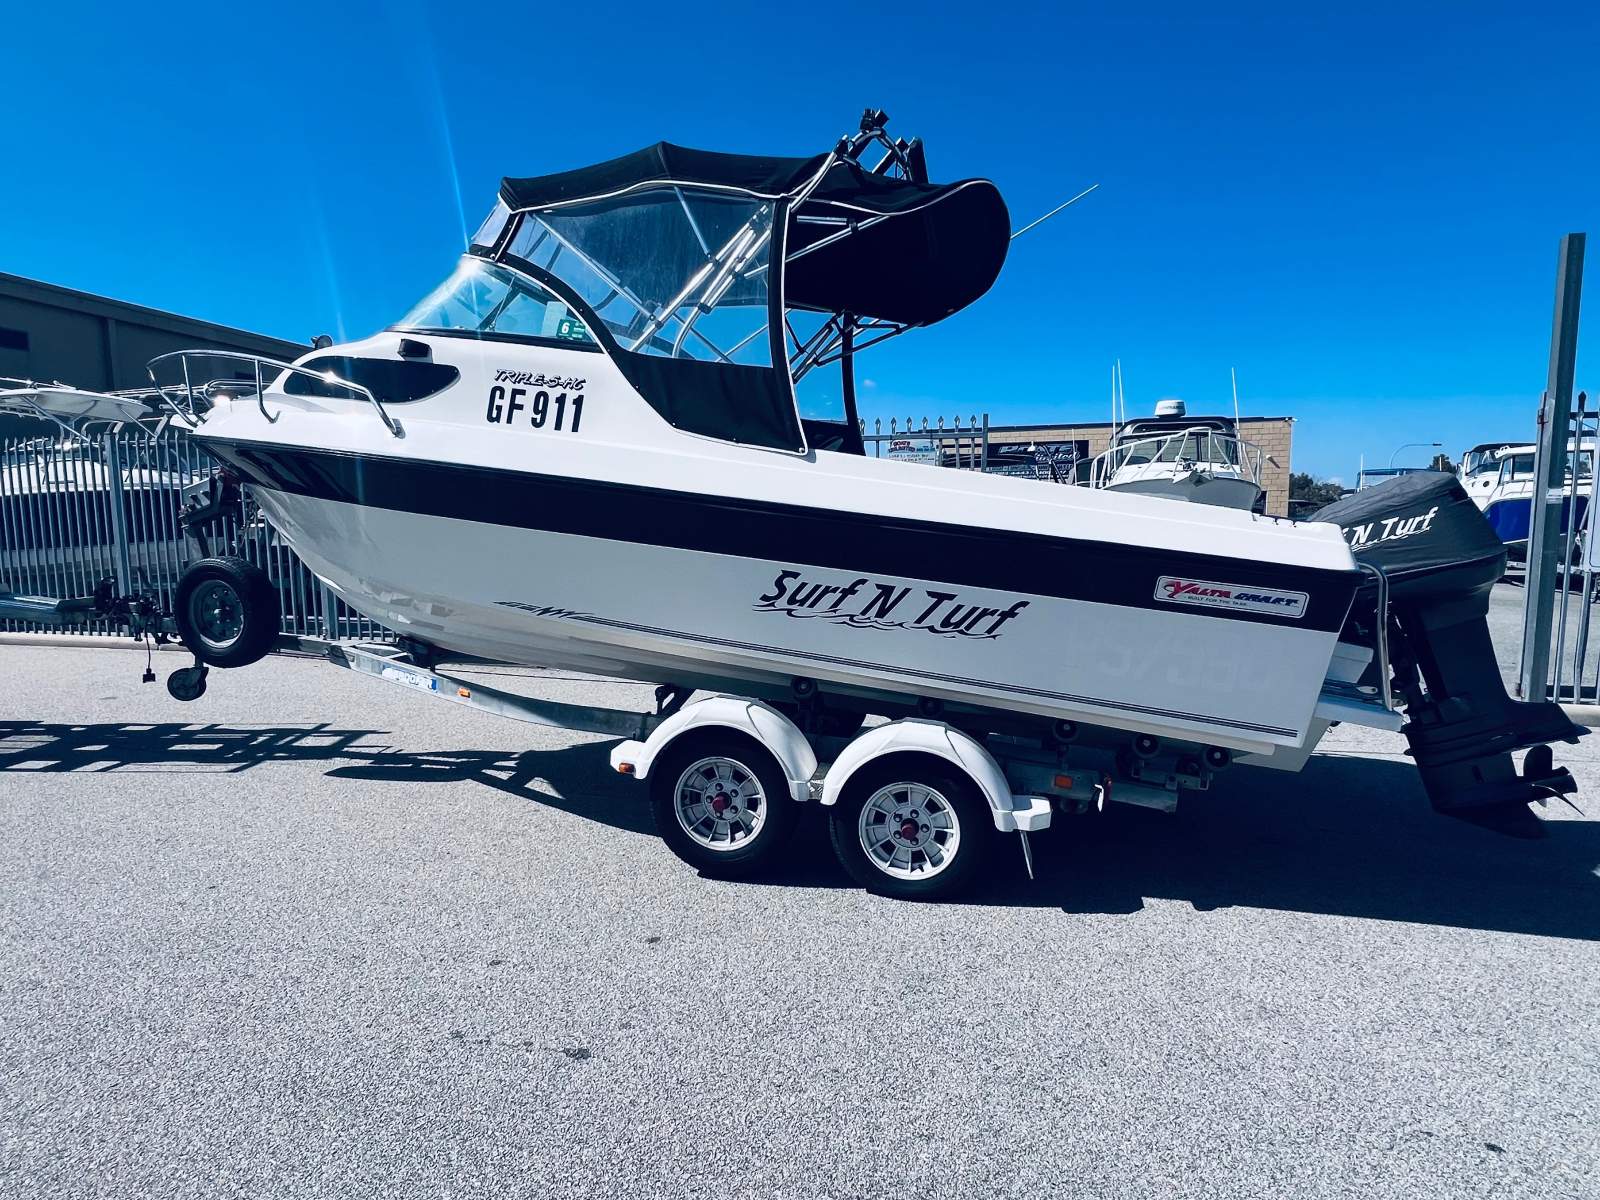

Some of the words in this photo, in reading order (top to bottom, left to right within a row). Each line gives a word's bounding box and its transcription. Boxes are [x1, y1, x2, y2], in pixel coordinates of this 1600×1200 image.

[561, 322, 570, 334] 6
[1351, 522, 1374, 546] N
[1380, 506, 1439, 539] Turf
[759, 569, 869, 609] Surf
[859, 583, 912, 619] N
[913, 590, 1030, 636] Turf
